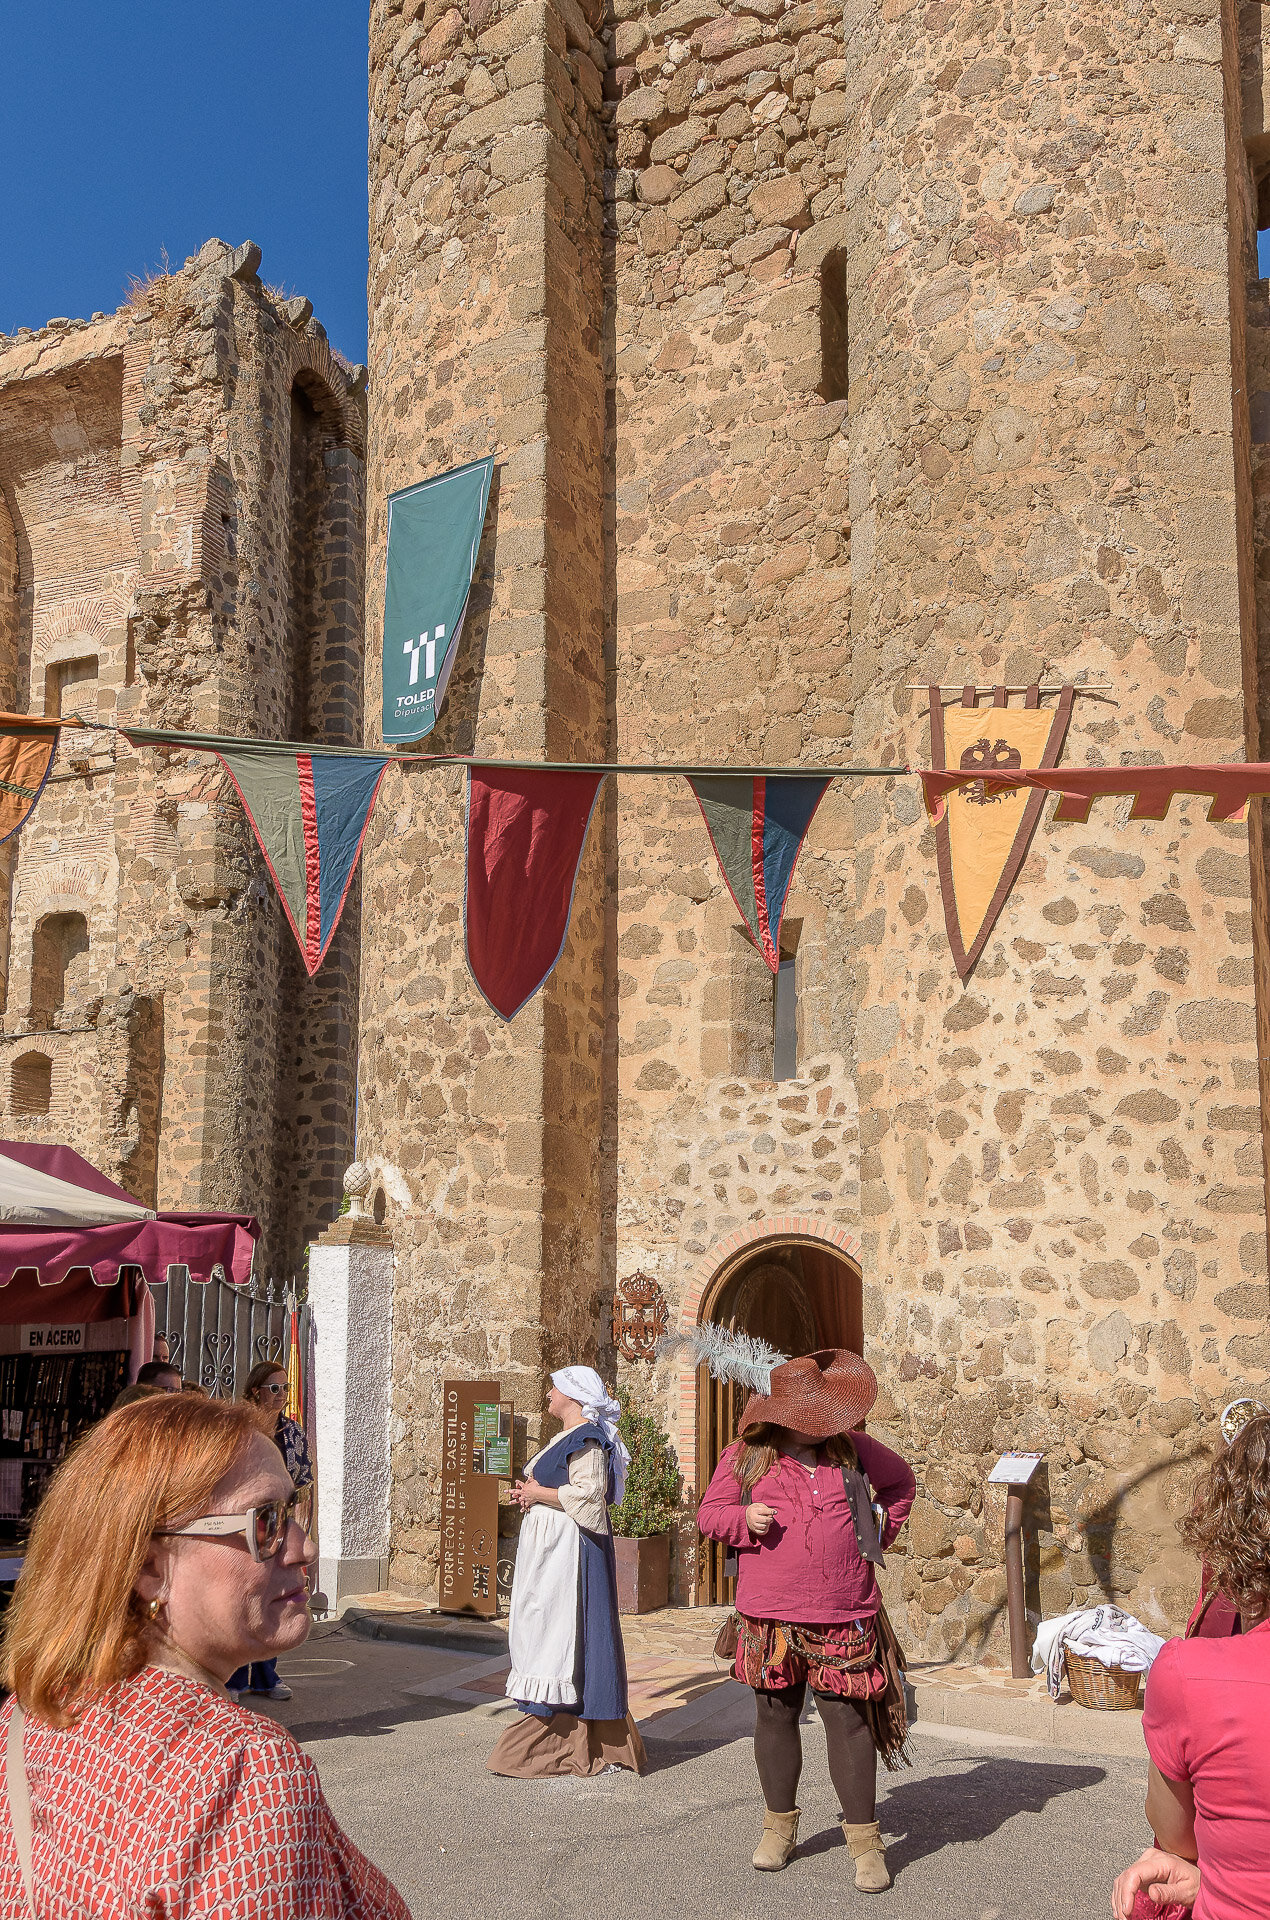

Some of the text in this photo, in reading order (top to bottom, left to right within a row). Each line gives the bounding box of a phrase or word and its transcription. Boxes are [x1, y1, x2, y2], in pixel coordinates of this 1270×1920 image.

[396, 688, 435, 708] TOLED
[394, 702, 434, 717] Diputaci
[30, 1330, 81, 1346] EN ACERO
[459, 1421, 468, 1485] TURISMO
[442, 1390, 458, 1598] TORREÓN DEL CASTILLO
